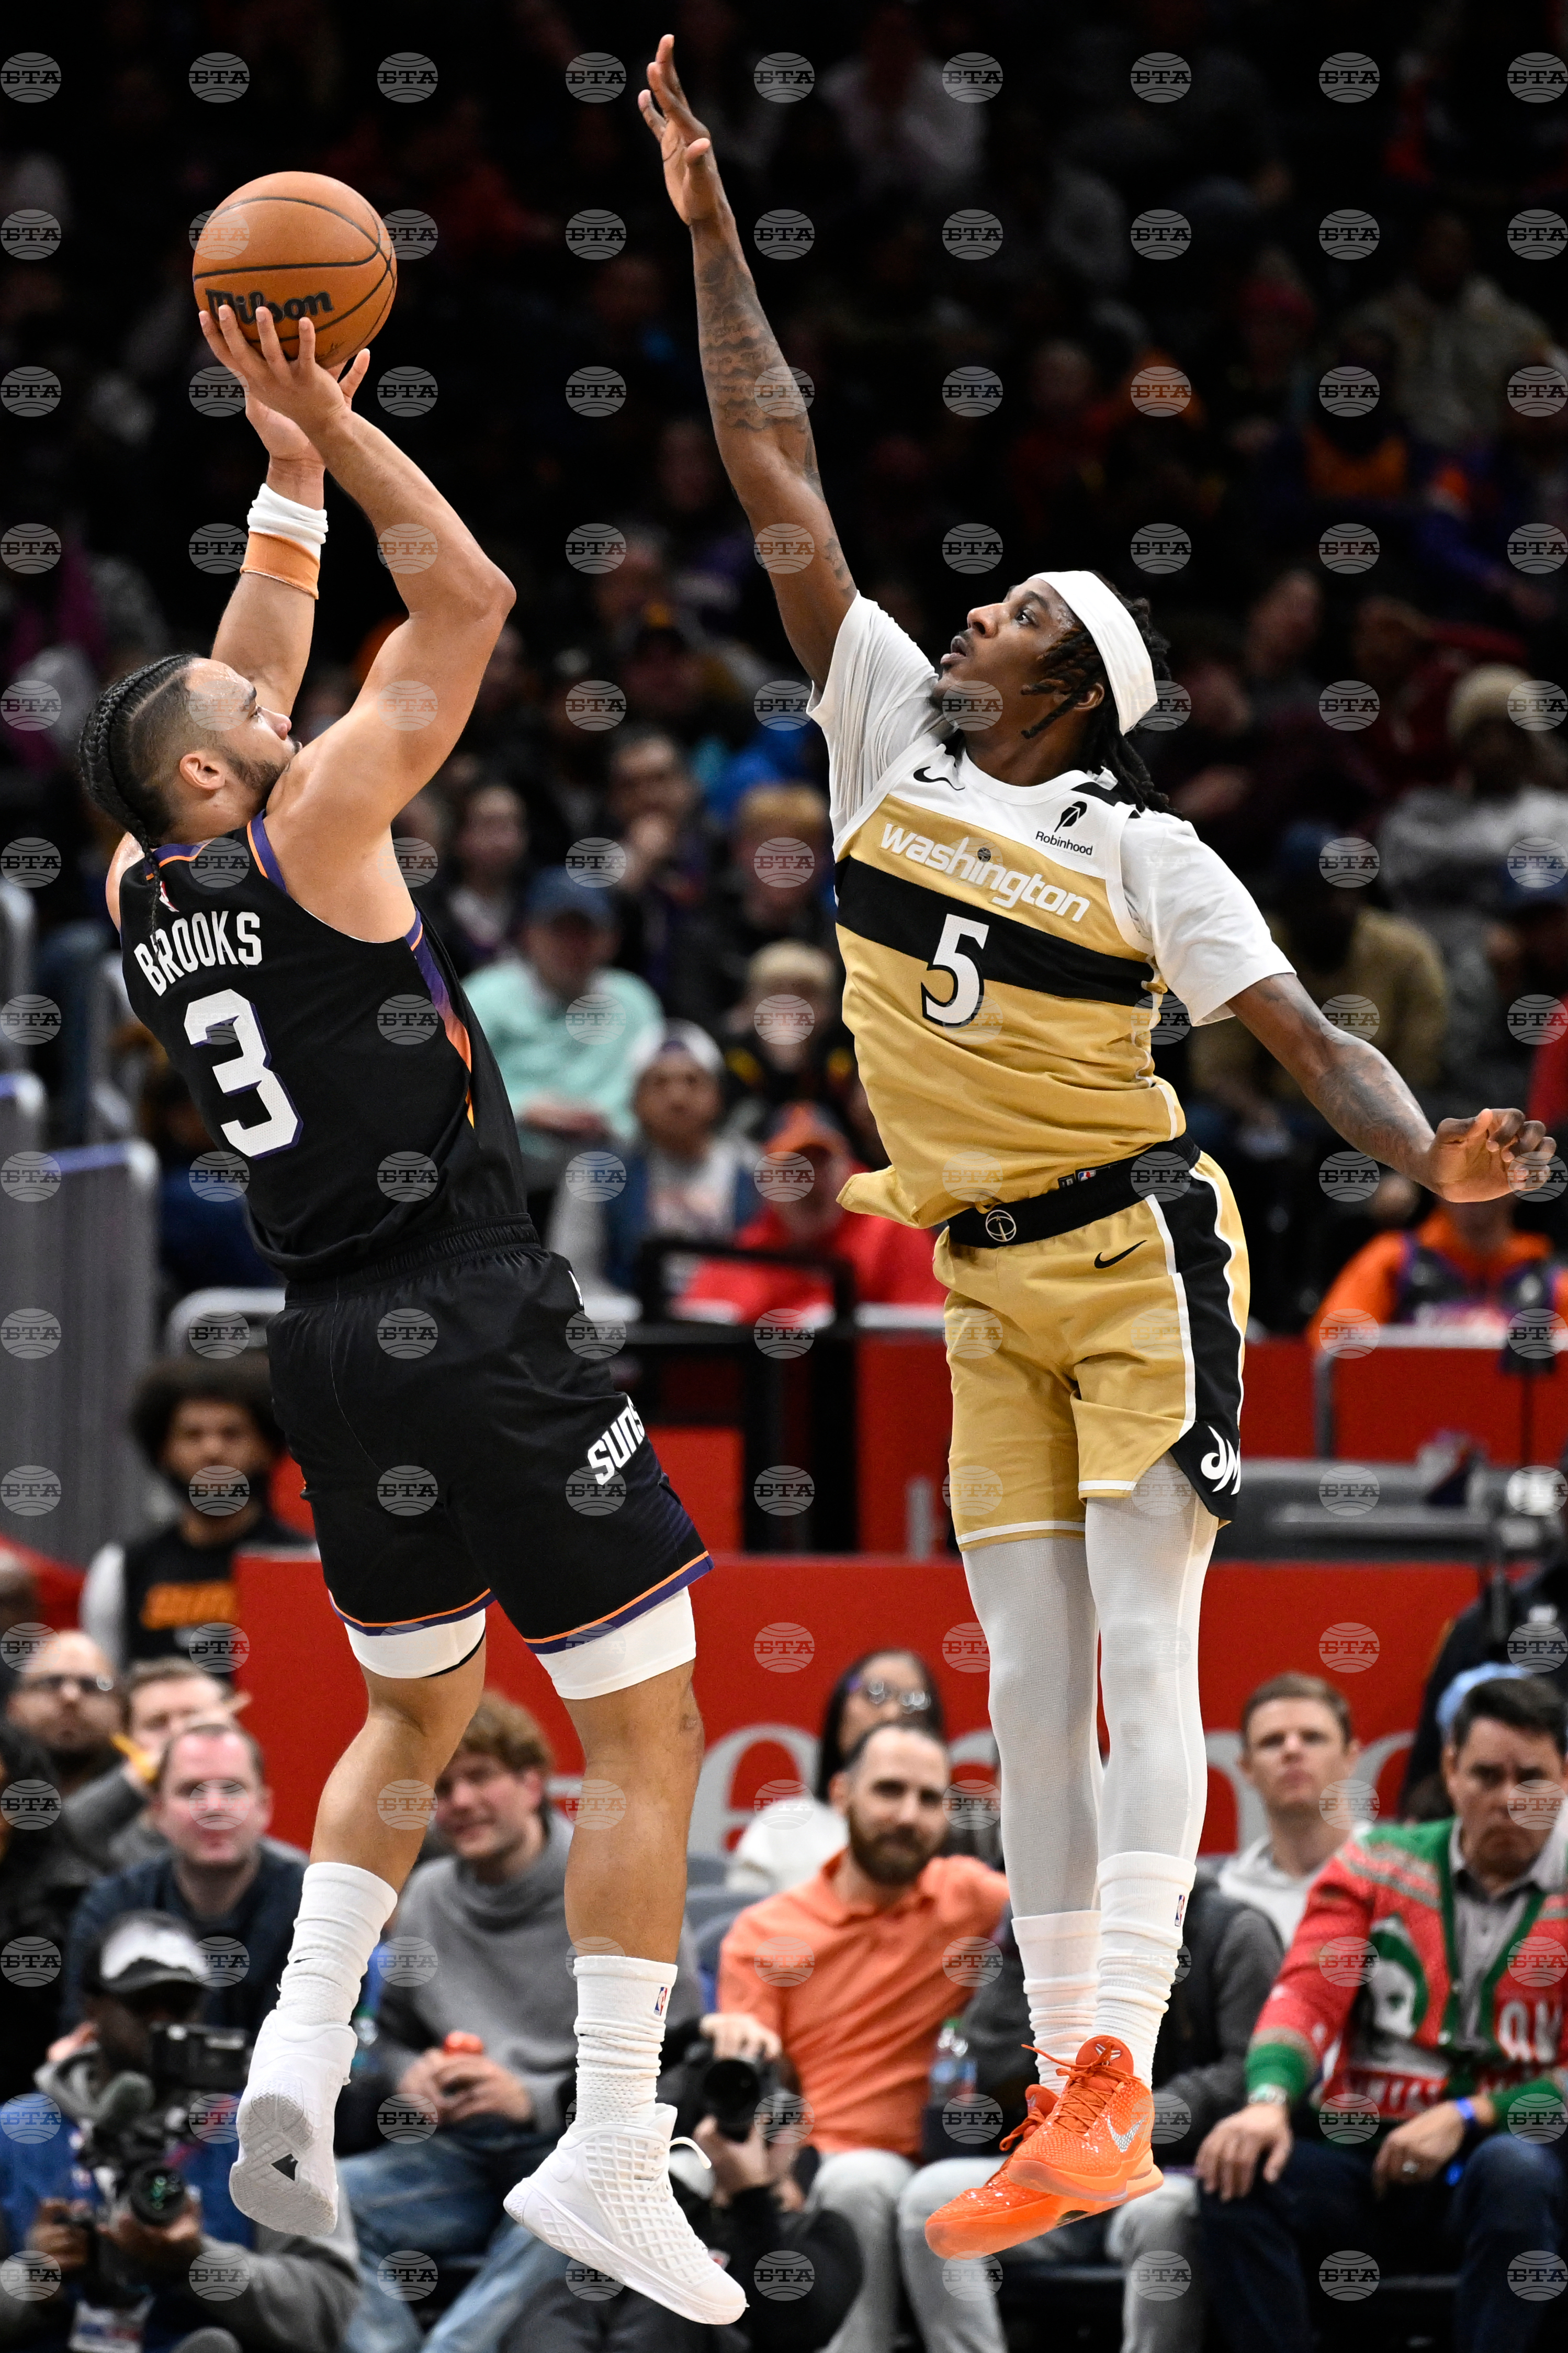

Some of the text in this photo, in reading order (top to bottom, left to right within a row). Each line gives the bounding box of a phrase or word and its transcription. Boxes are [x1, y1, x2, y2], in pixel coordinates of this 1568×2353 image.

[879, 823, 1090, 922] washington
[1035, 831, 1093, 856] Robinhood
[134, 910, 262, 996] BROOKS
[921, 913, 990, 1027] 5
[183, 989, 303, 1160] 3
